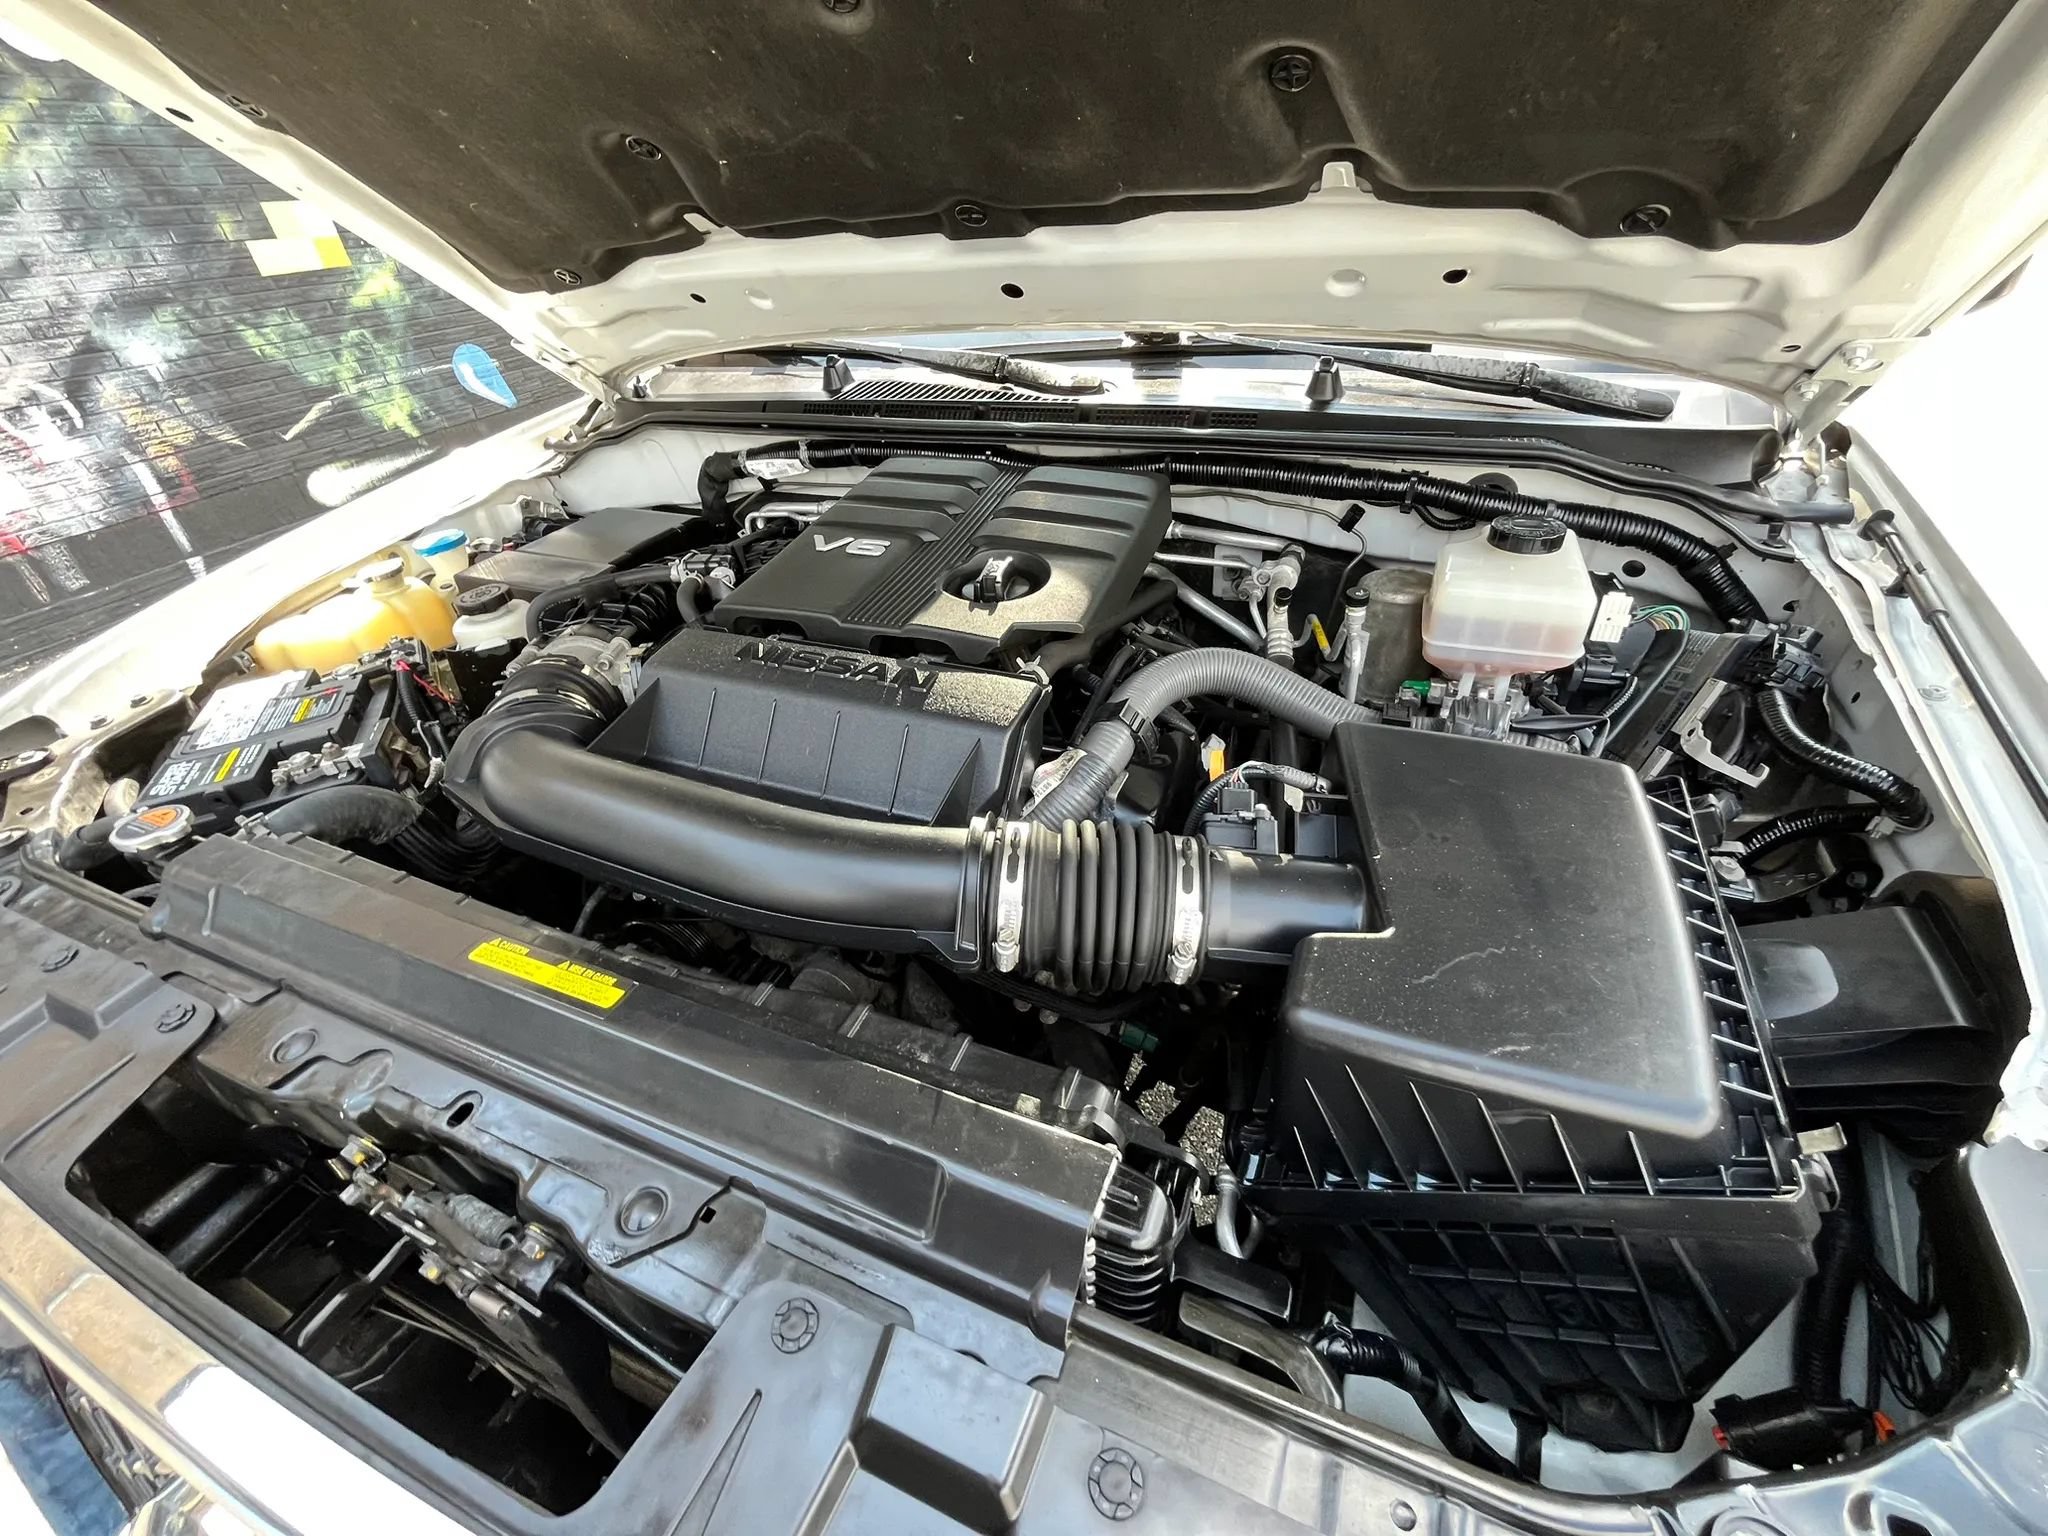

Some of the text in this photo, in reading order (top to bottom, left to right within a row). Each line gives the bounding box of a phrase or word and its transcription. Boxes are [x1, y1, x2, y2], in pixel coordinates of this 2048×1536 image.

[813, 534, 891, 556] V6
[734, 640, 939, 692] NISSAN
[499, 940, 530, 956] CAUTION
